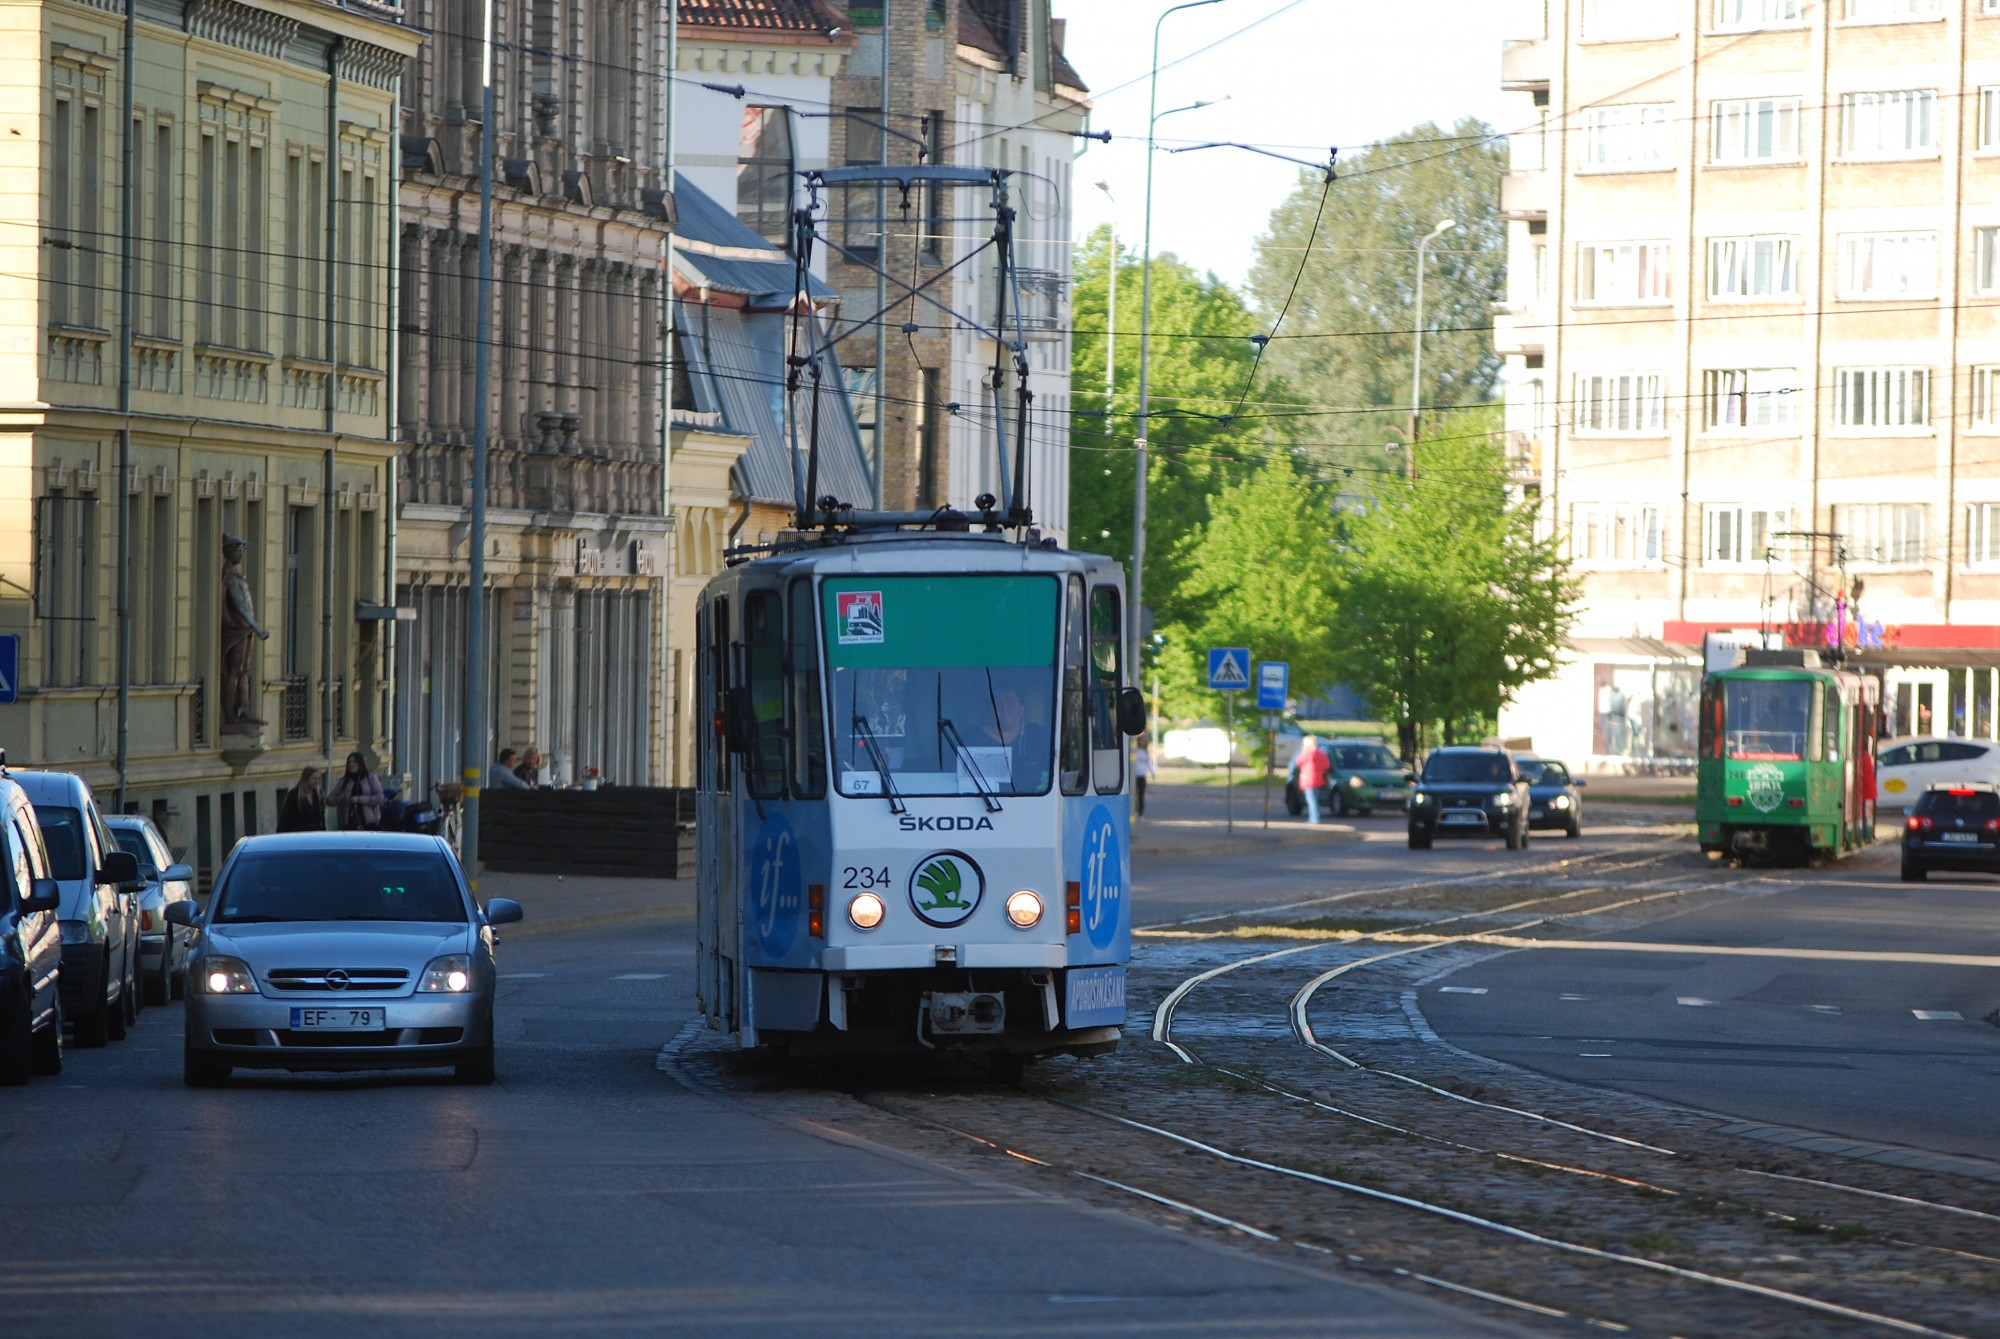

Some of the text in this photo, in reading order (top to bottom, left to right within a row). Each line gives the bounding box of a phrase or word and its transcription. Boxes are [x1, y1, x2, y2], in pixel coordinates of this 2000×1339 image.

[852, 780, 870, 791] 67
[899, 813, 994, 832] ŠKODA
[843, 866, 892, 889] 234
[349, 1010, 370, 1026] 79
